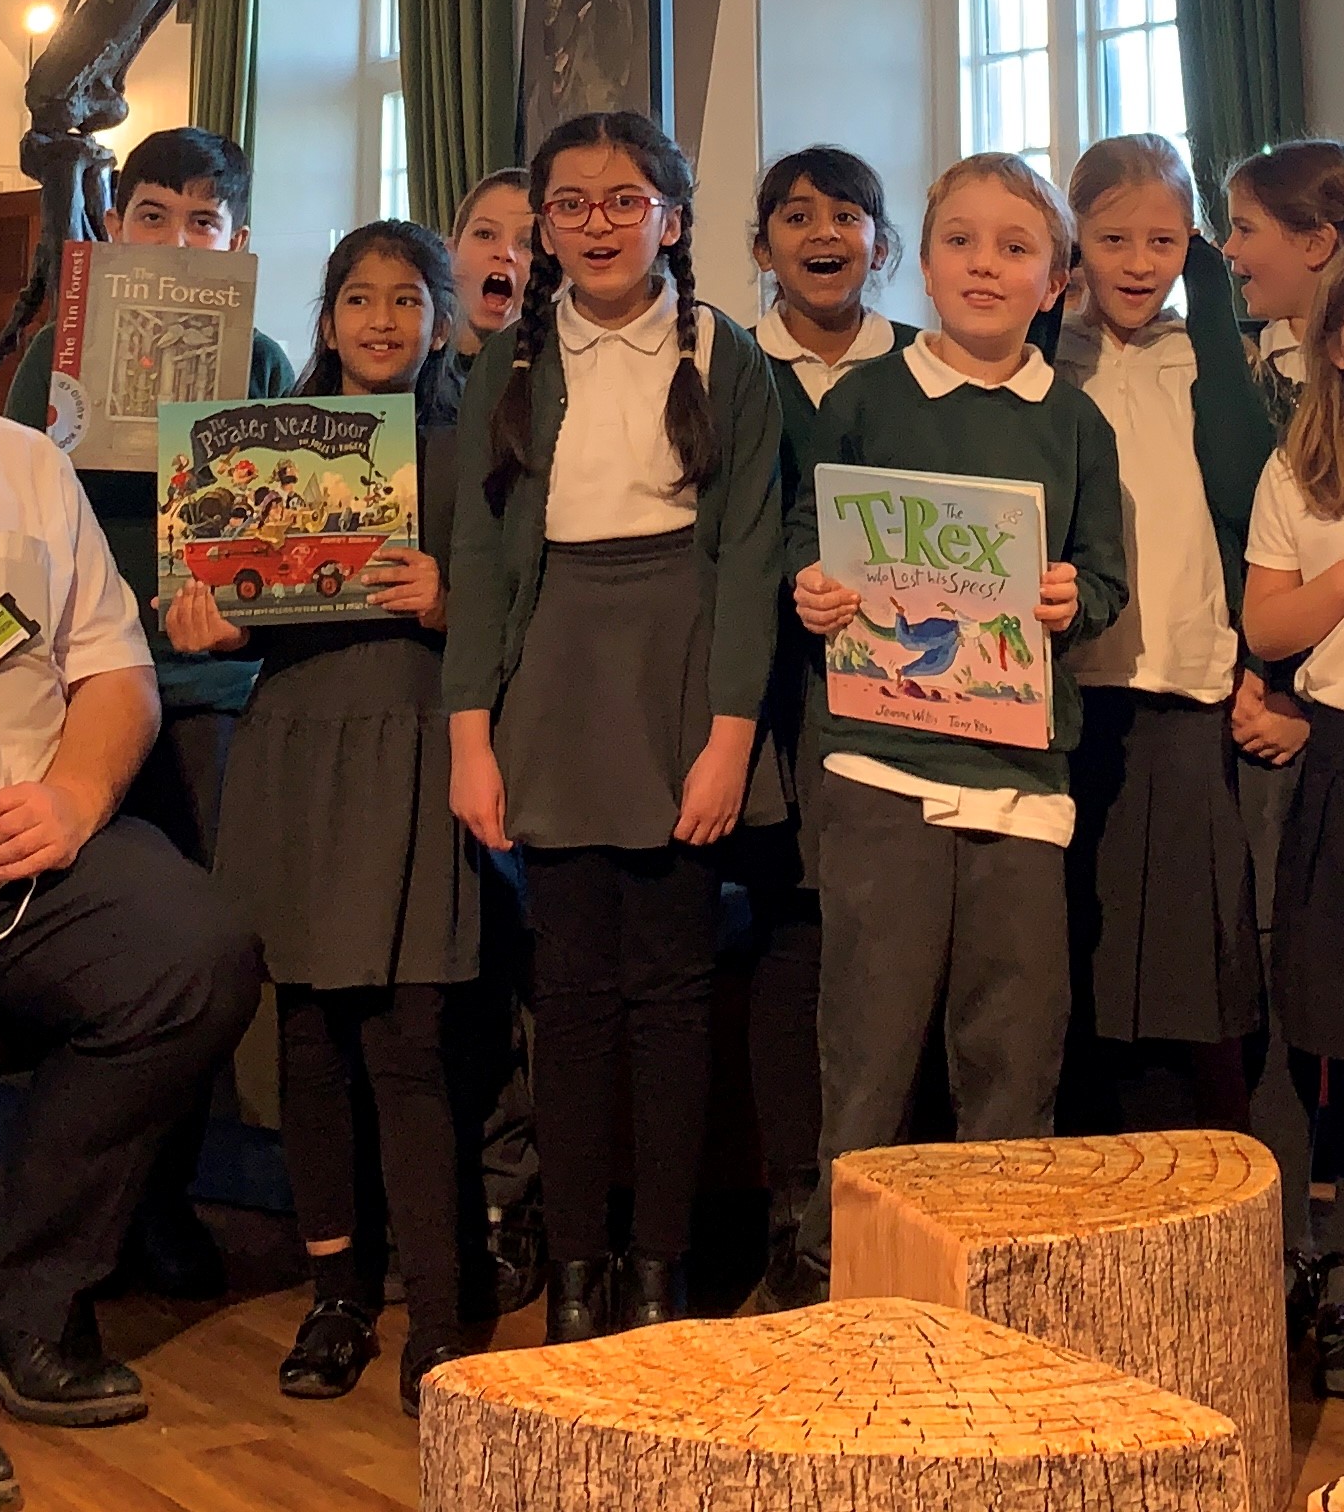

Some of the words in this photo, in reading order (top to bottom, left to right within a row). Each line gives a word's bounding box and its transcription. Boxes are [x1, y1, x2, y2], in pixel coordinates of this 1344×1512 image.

[65, 249, 86, 301] Forest
[104, 273, 150, 300] Tin
[158, 276, 242, 309] Forest
[62, 304, 79, 330] Tin
[58, 336, 77, 369] The
[197, 418, 269, 458] Pirates
[273, 414, 318, 442] Next
[323, 415, 369, 441] Door
[942, 502, 964, 520] The
[834, 491, 1015, 578] T-Rex
[867, 566, 889, 585] who
[890, 565, 924, 590] Lost
[927, 570, 948, 585] his
[943, 572, 1006, 602] Specs!
[948, 714, 972, 733] Tony
